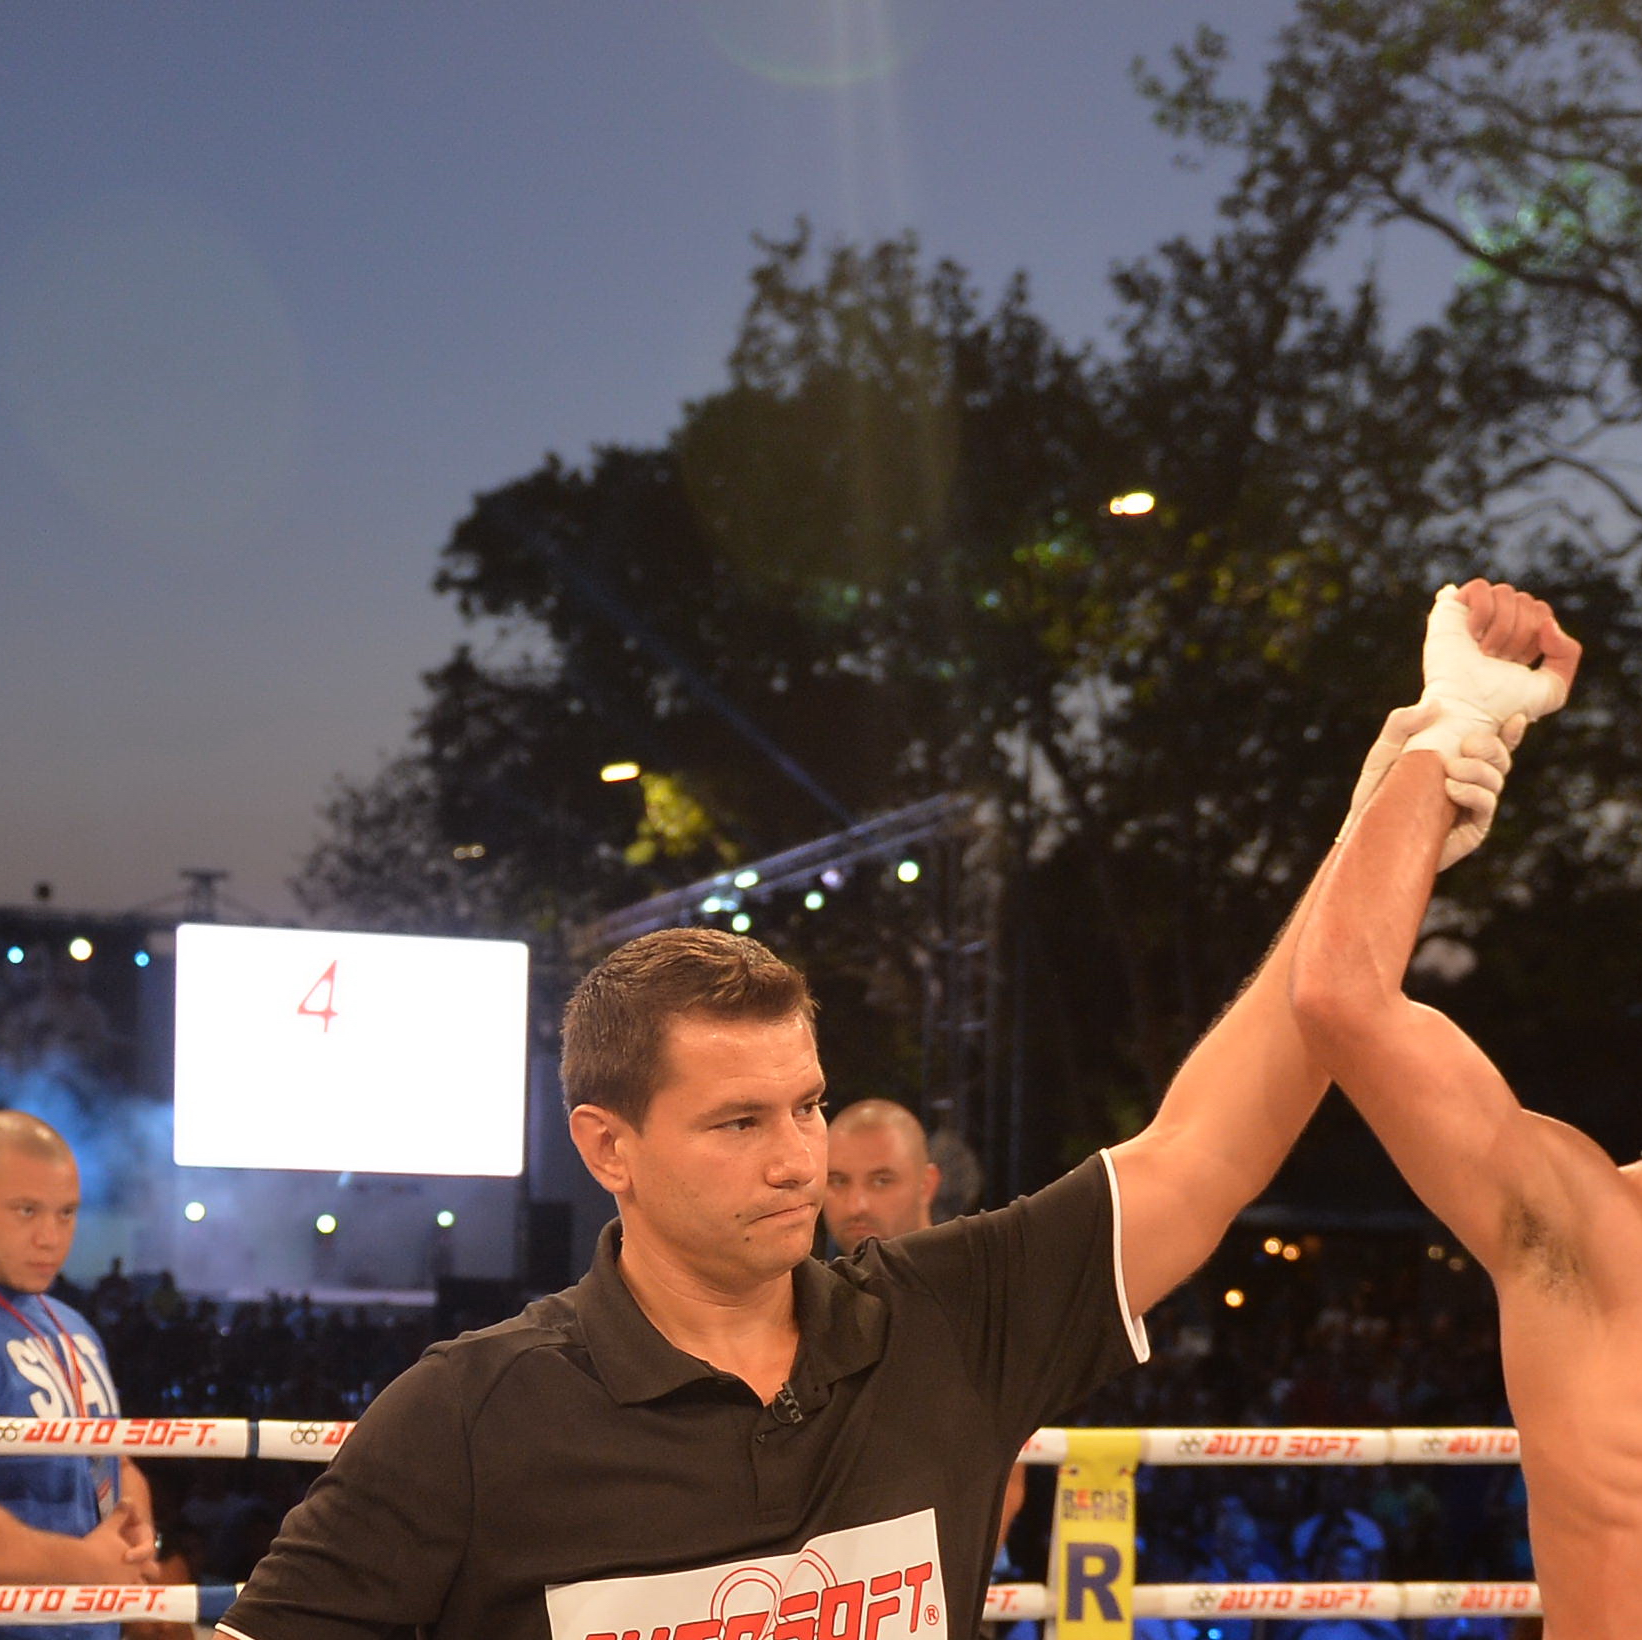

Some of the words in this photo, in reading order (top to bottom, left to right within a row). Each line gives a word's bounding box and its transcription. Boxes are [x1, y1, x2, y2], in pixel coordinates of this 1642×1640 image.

[297, 959, 338, 1032] 4
[24, 1419, 117, 1444] AUTO
[123, 1419, 216, 1446] SOFT
[1205, 1434, 1280, 1456] AUTO
[72, 1587, 166, 1612] SOFT
[1218, 1589, 1294, 1611] AUTO
[1460, 1588, 1531, 1609] AUTO
